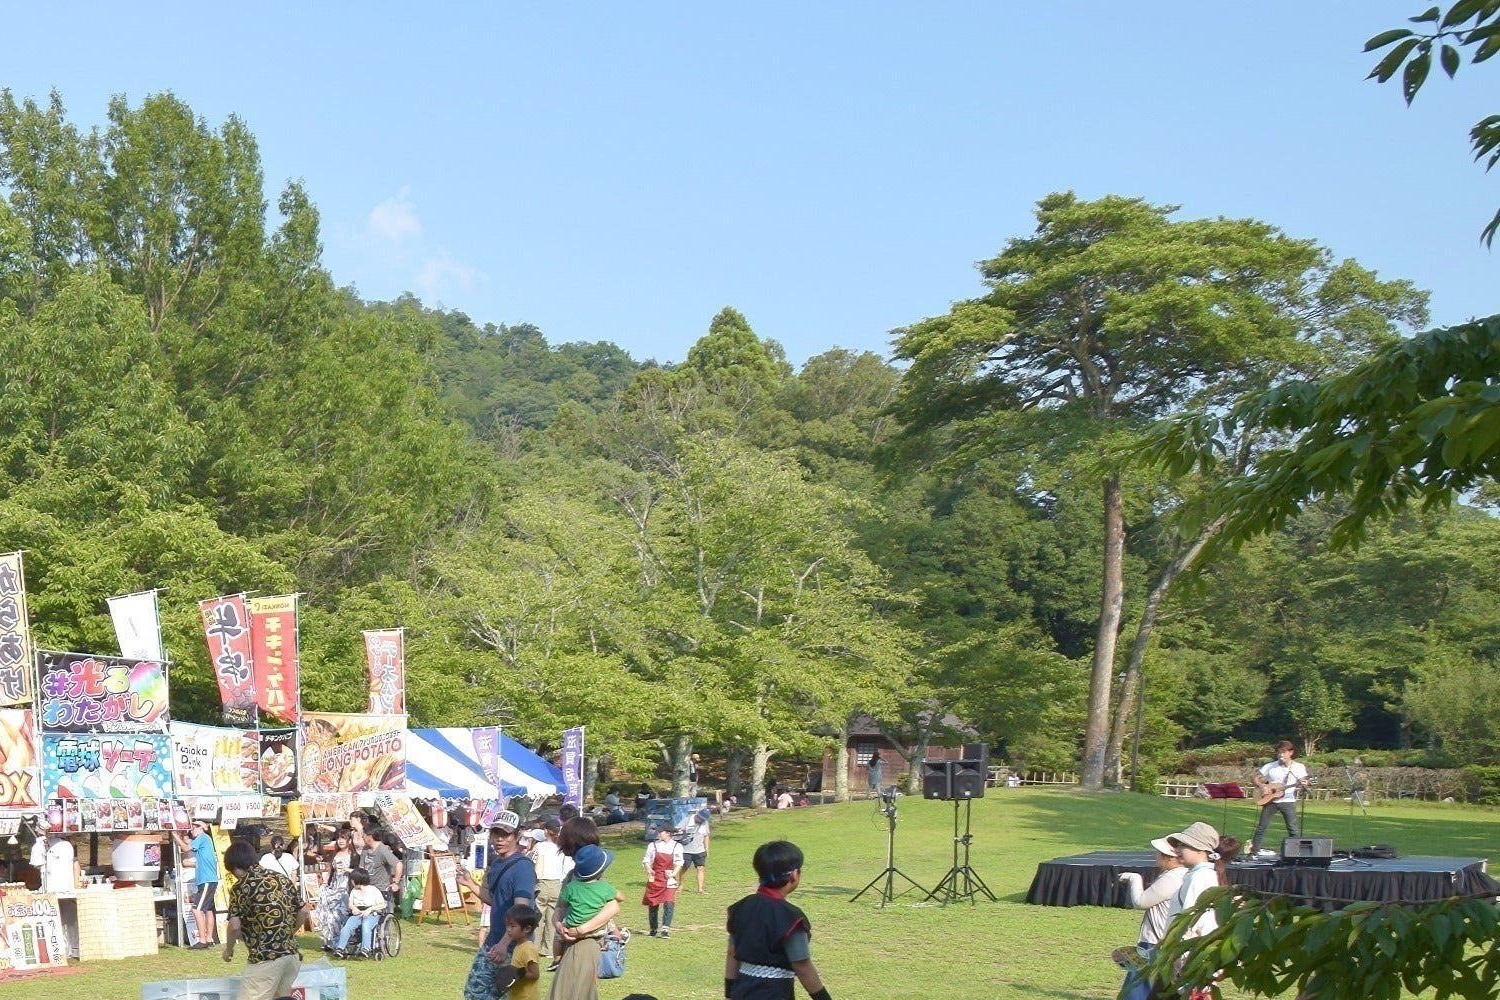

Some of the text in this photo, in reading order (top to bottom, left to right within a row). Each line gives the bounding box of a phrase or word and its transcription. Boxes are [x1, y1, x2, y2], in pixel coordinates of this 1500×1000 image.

[42, 660, 130, 697] #光る
[43, 693, 153, 725] わたがし
[322, 738, 402, 773] LONG POTATO
